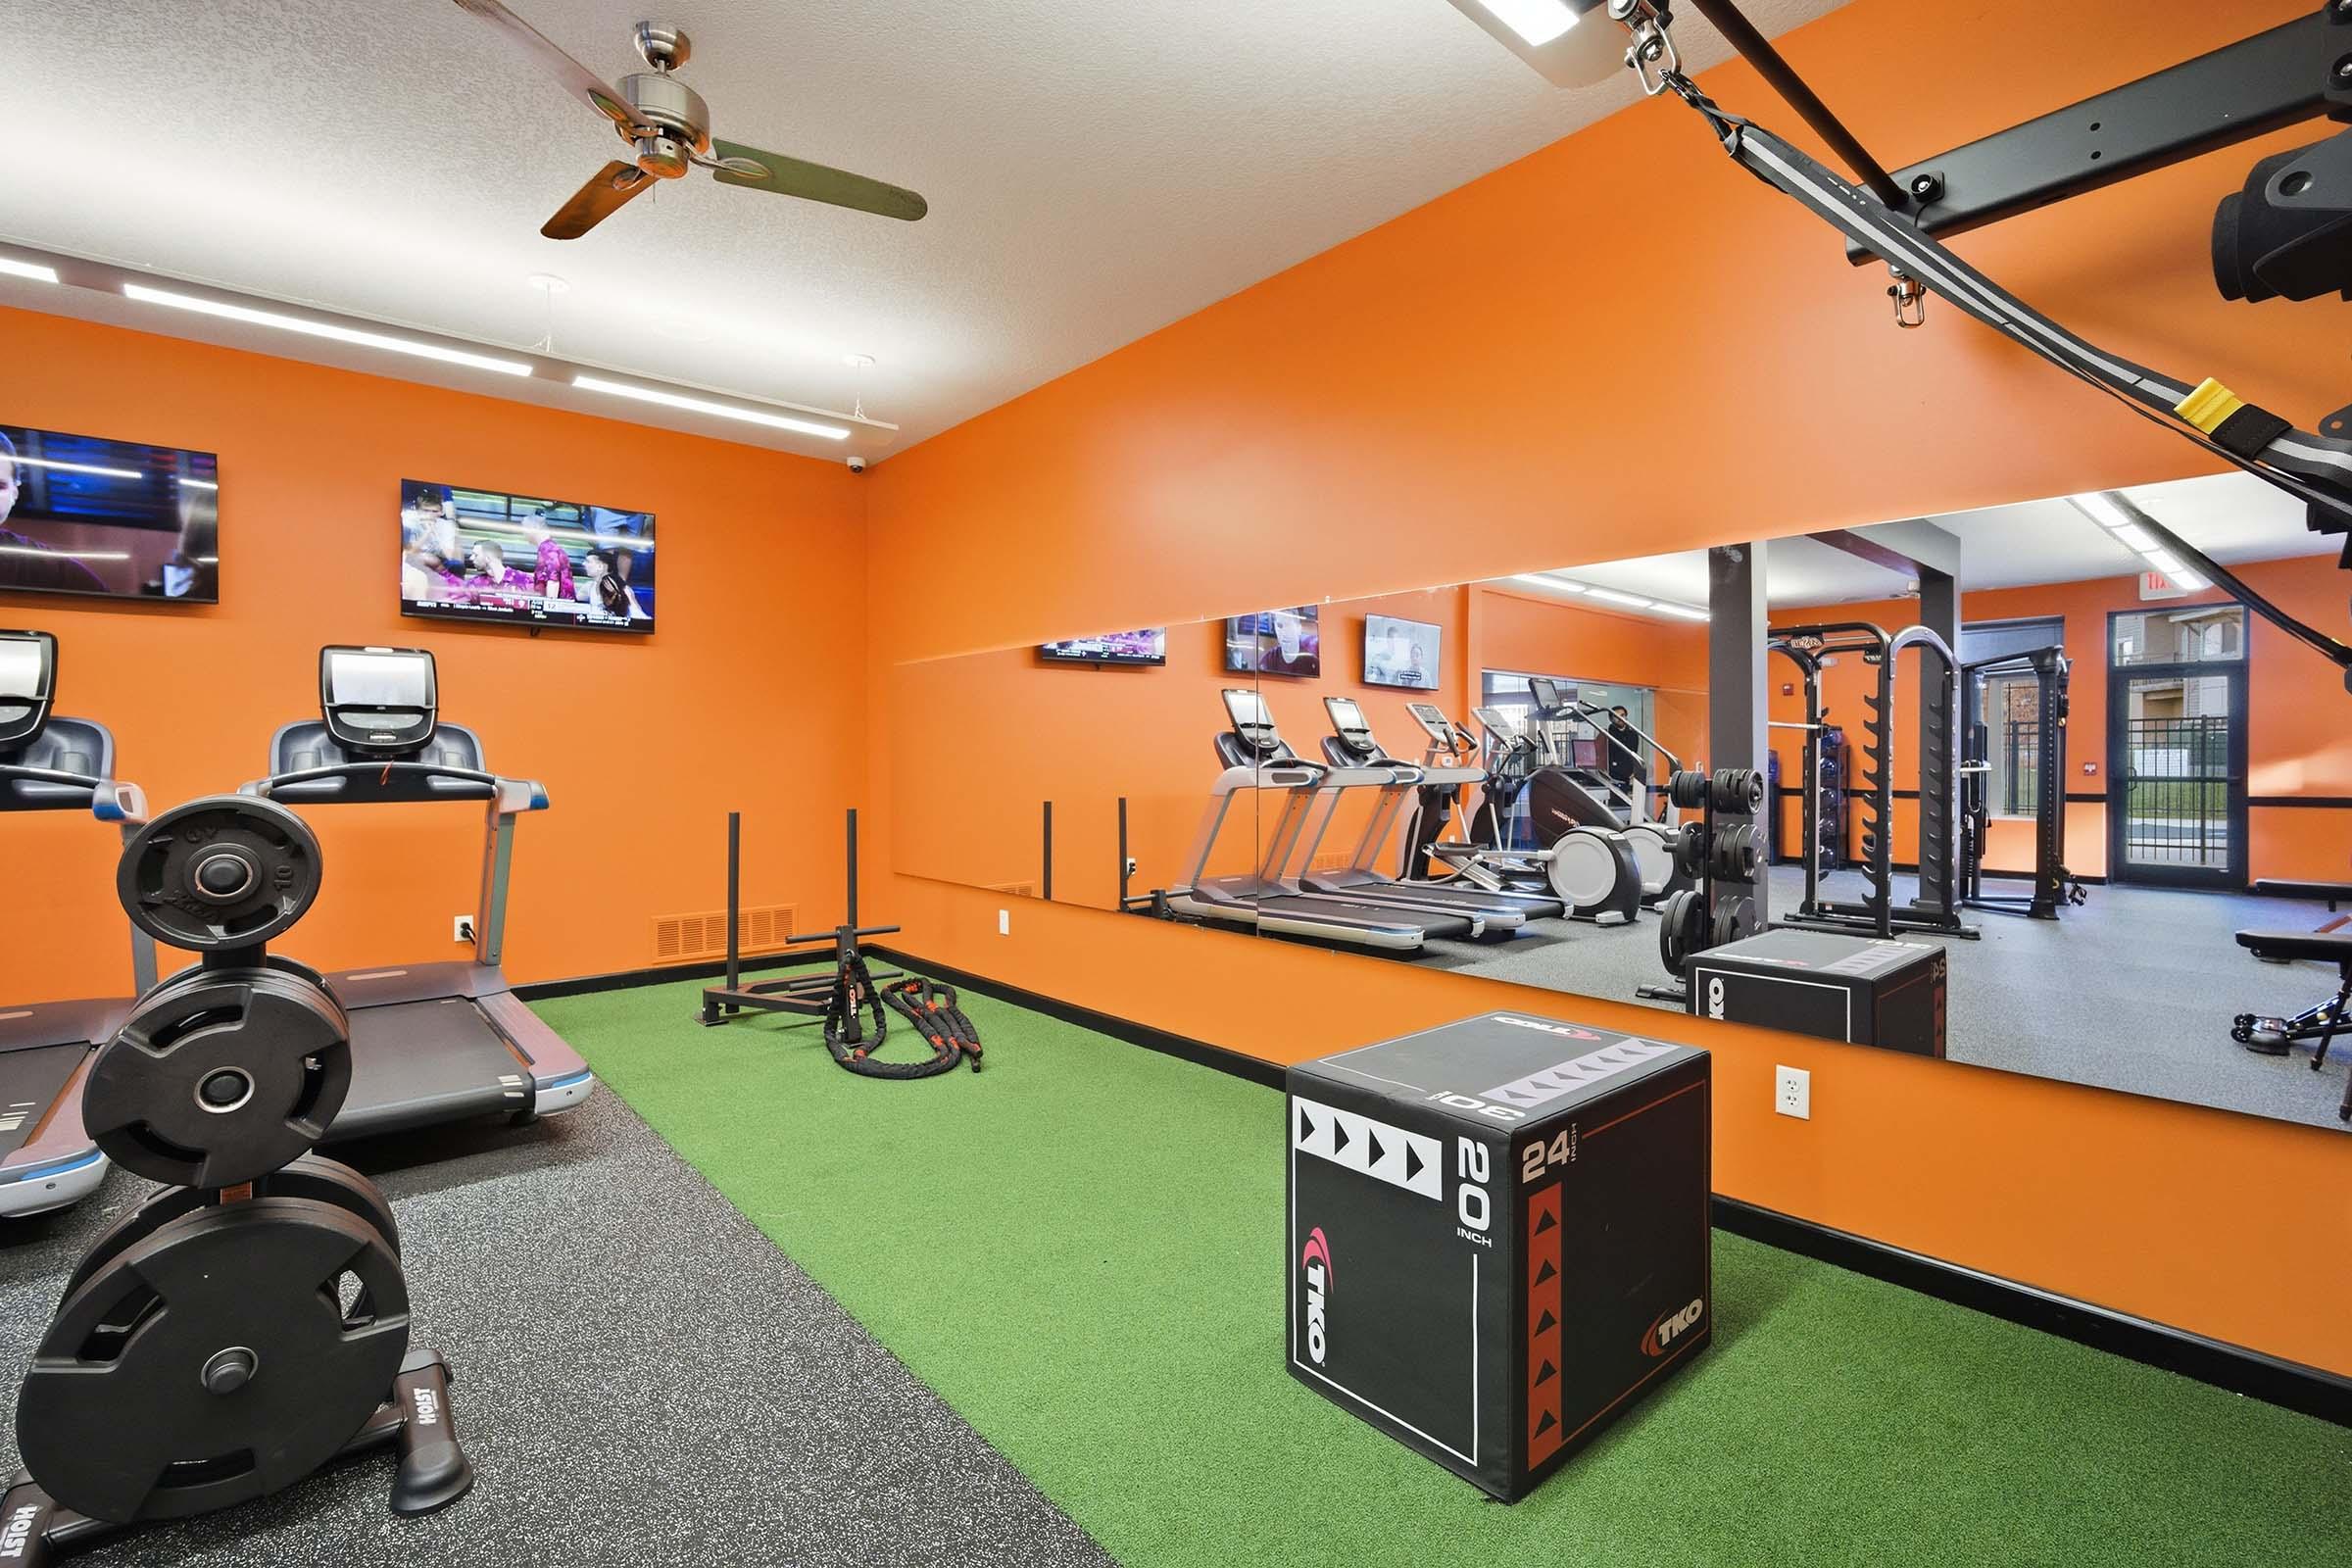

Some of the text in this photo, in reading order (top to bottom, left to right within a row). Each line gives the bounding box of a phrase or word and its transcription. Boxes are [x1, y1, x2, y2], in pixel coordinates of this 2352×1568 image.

[1440, 1095, 1526, 1120] 30
[1522, 1129, 1569, 1183] 24
[1458, 1136, 1490, 1231] 20
[1457, 1227, 1492, 1248] INCH
[1307, 1264, 1325, 1363] TKO
[1658, 1298, 1703, 1346] TKO
[414, 1388, 437, 1424] HOIST
[0, 1505, 37, 1557] HOIST
